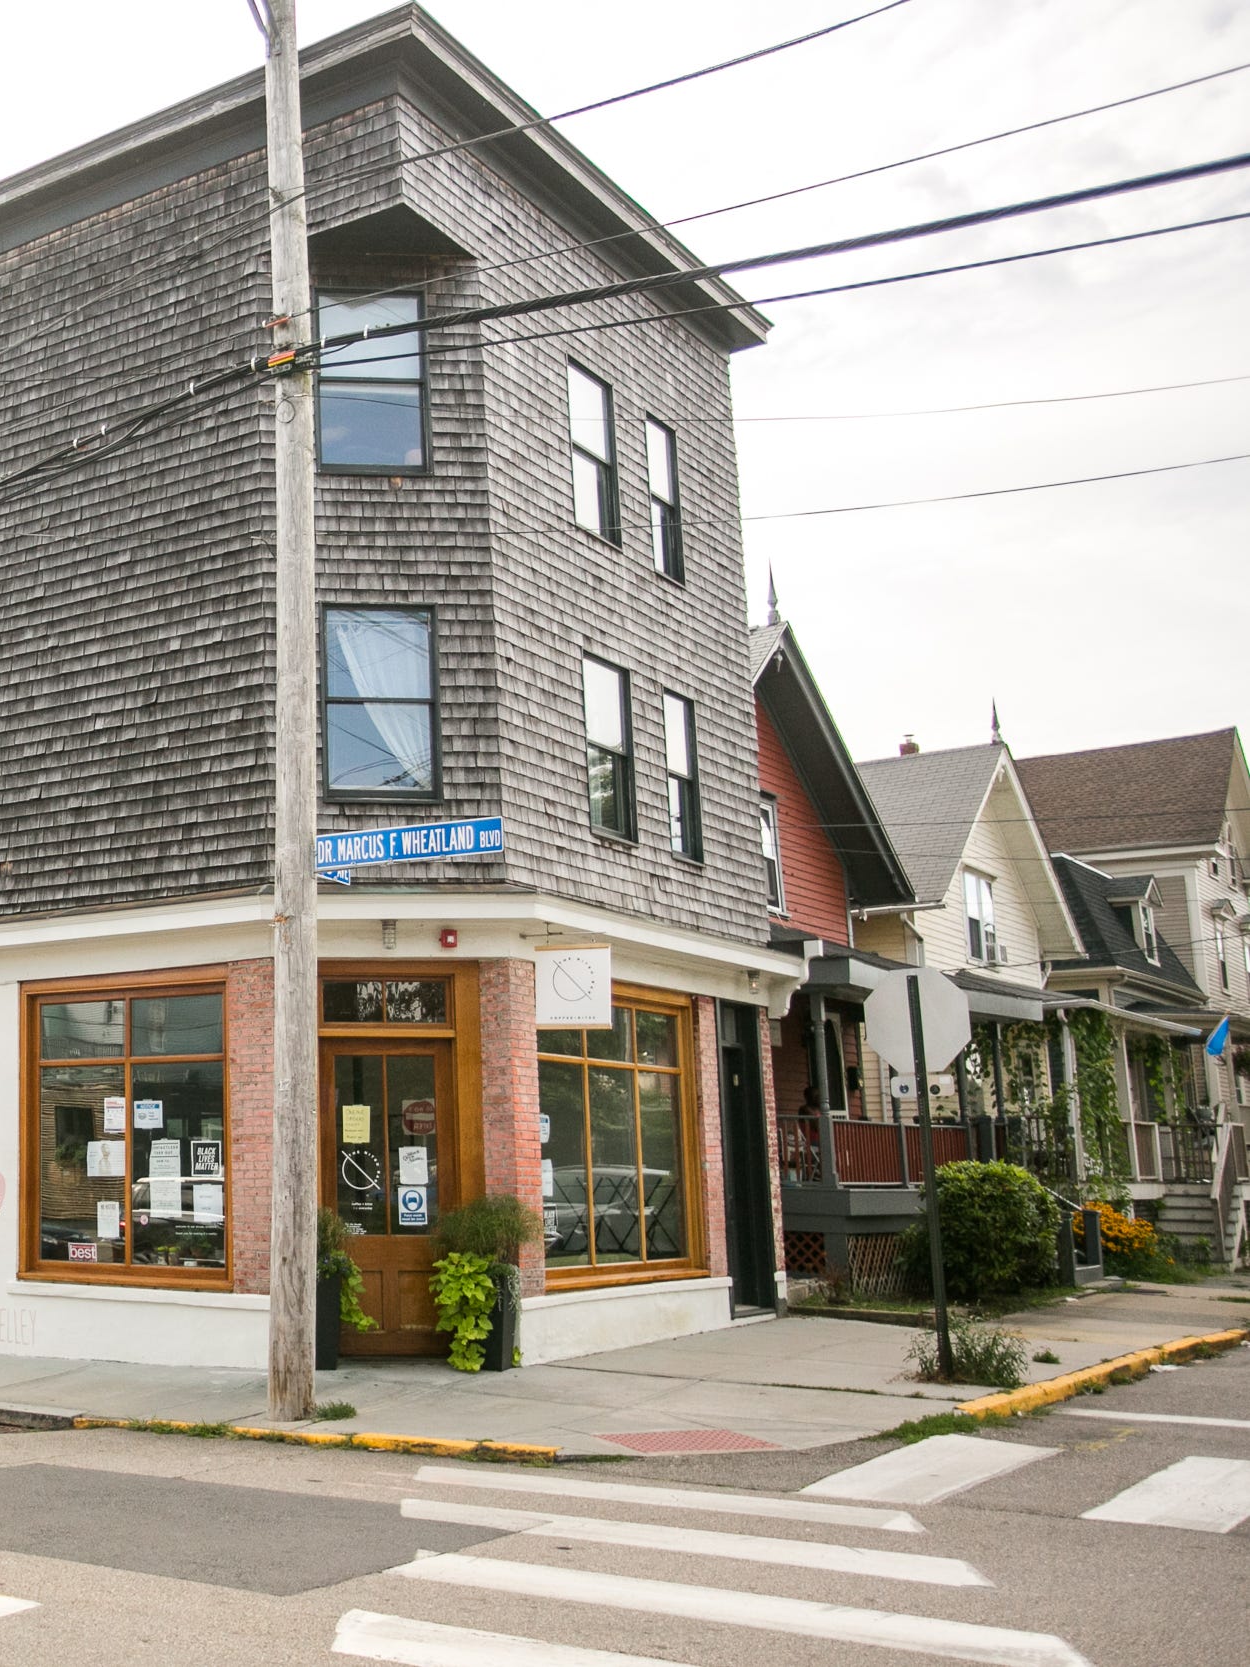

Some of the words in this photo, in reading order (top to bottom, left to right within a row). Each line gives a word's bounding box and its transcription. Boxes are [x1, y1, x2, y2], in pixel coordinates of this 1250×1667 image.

[318, 839, 337, 864] DR.
[337, 833, 385, 862] MARCUS
[389, 832, 399, 857] F.
[401, 825, 475, 856] WHEATLAND
[479, 829, 501, 849] BLVD
[197, 1147, 216, 1155] BLACK
[198, 1155, 215, 1163] LIVES
[195, 1162, 219, 1171] MATTER
[70, 1244, 97, 1259] best
